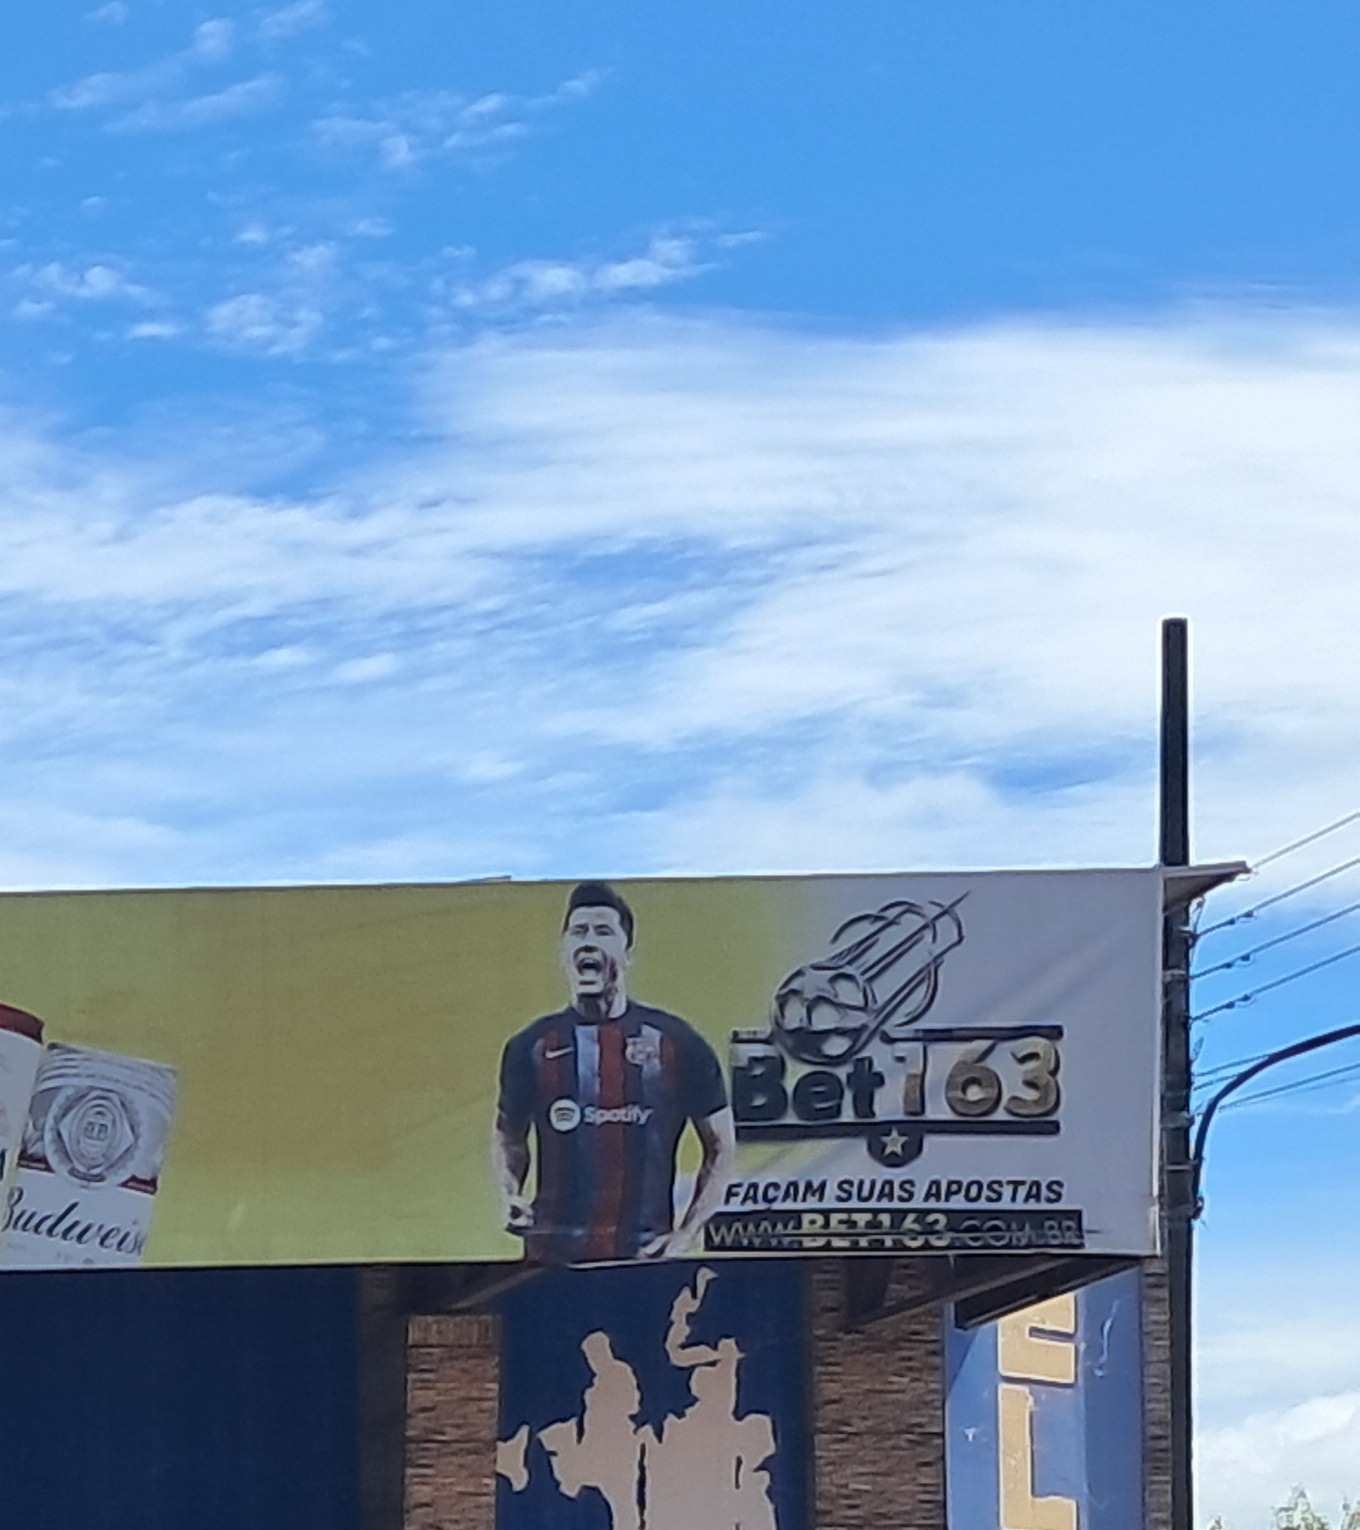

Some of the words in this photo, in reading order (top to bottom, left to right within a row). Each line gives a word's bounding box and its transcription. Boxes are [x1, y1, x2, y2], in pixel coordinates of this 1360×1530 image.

[583, 1103, 655, 1126] Spotify
[835, 1179, 916, 1205] SUAS
[922, 1177, 1065, 1204] APOSTAS
